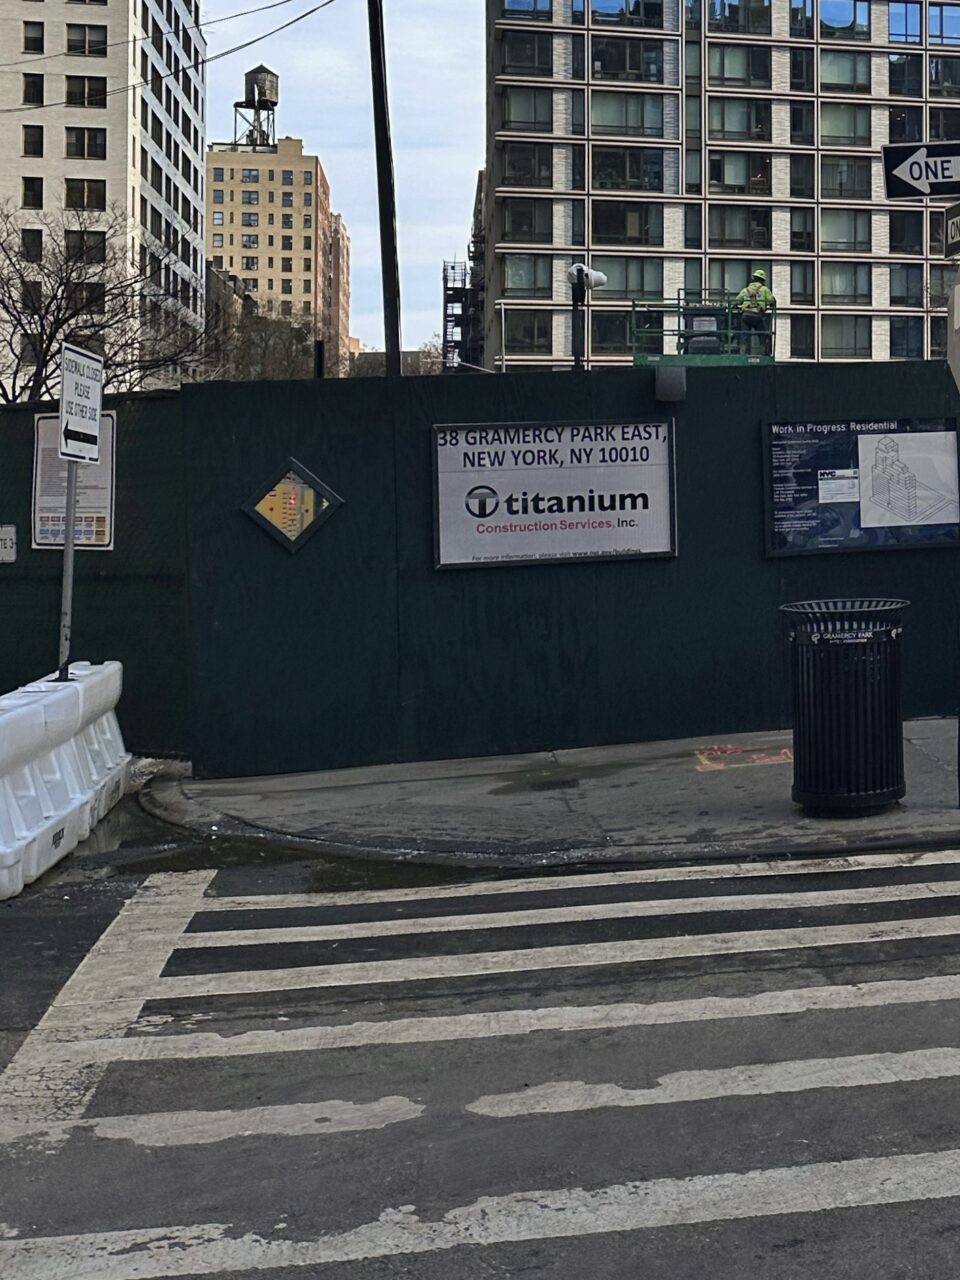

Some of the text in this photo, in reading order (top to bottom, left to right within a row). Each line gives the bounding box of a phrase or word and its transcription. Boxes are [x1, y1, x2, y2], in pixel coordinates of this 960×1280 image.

[909, 160, 953, 181] ONE
[65, 357, 101, 382] SIDEWALK CLOSED
[75, 381, 91, 399] PLEASE
[66, 400, 98, 422] USE OTHER SIDE
[438, 424, 667, 446] 38 GRAMERCY PARK EAST,
[772, 424, 794, 434] Work
[796, 423, 805, 433] in
[850, 420, 898, 431] Residential
[463, 446, 650, 468] NEW YORK, NY 10010
[504, 489, 649, 516] titanium
[476, 521, 557, 534] Construction
